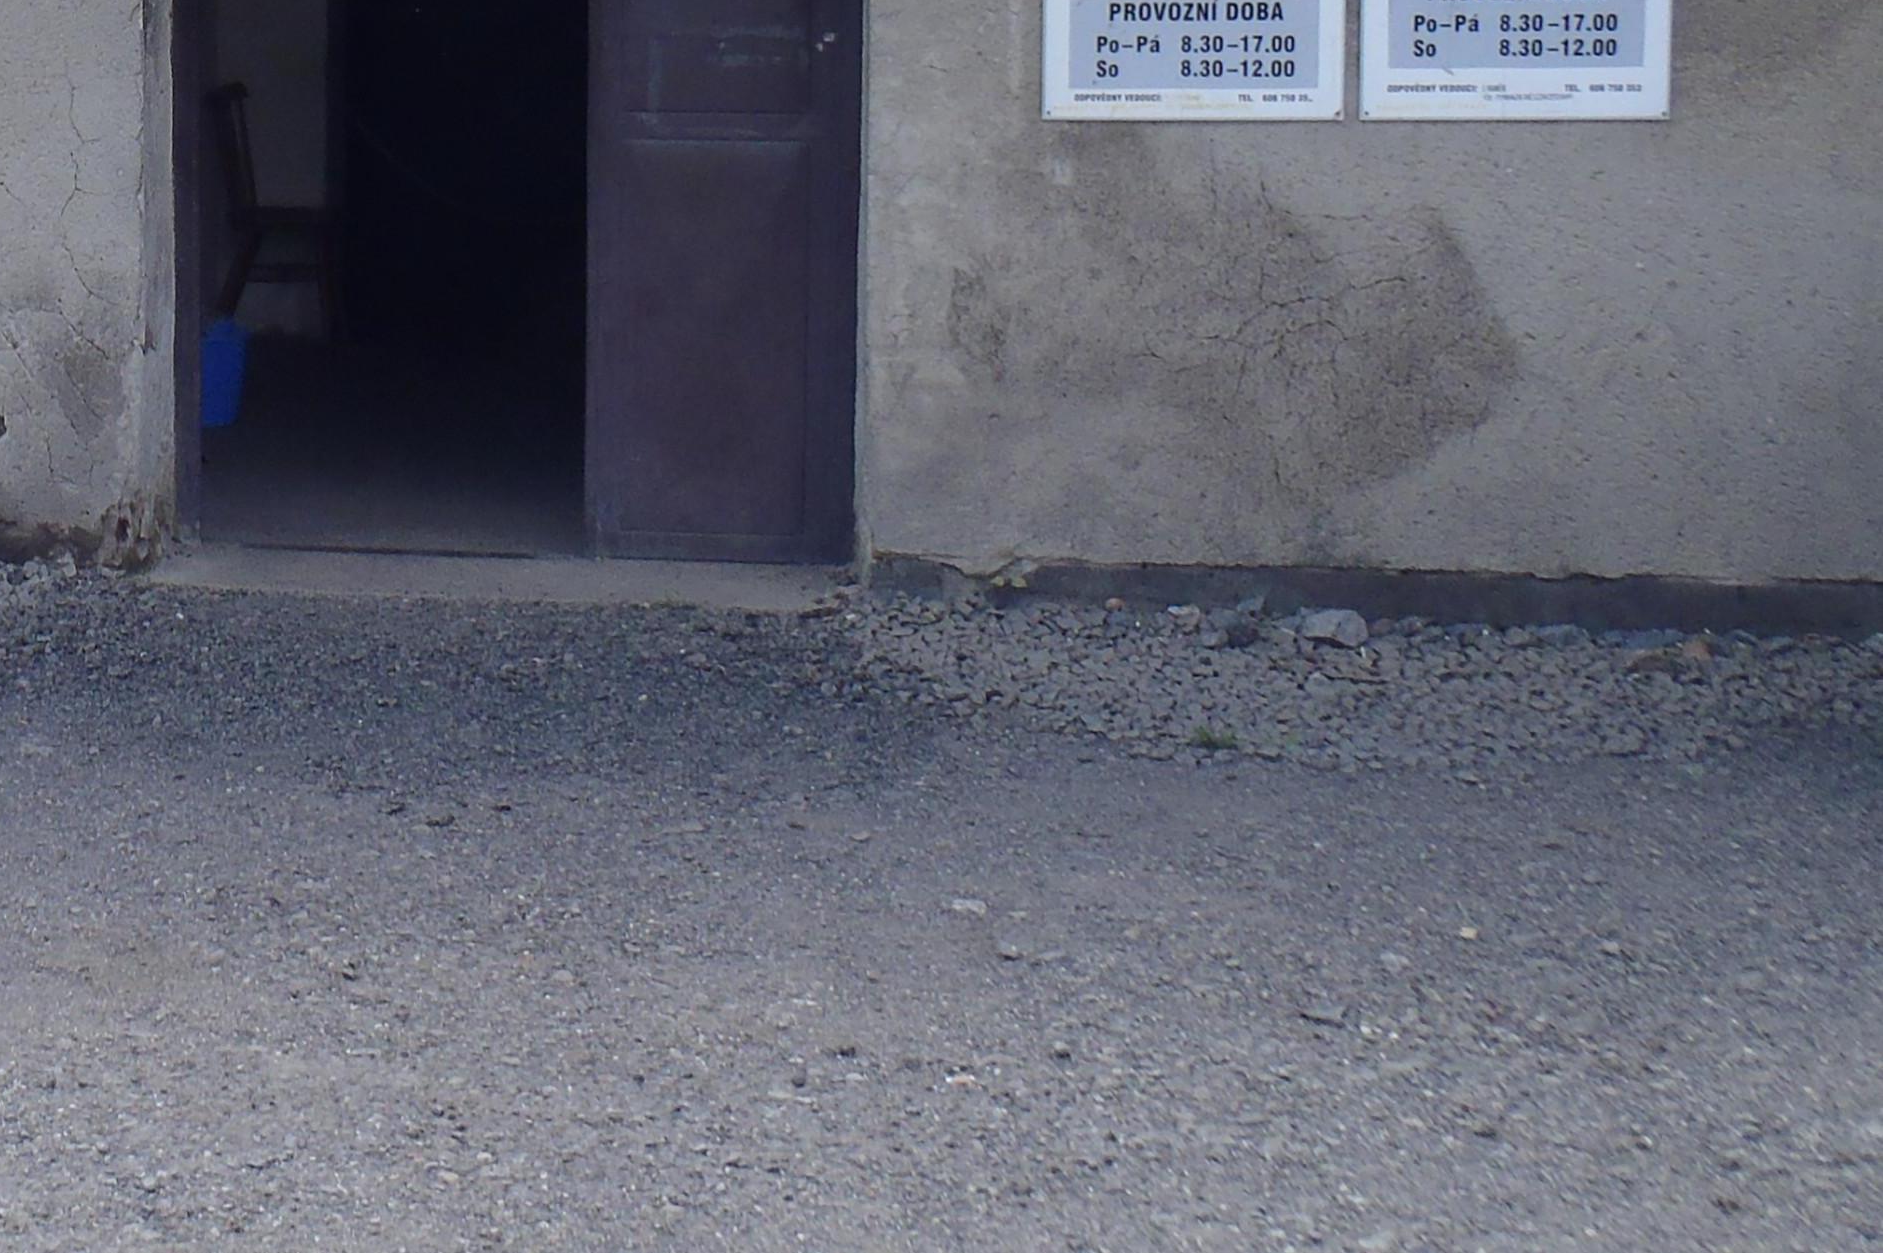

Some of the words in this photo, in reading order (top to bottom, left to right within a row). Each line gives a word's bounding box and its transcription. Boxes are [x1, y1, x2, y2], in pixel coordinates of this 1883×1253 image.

[1225, 0, 1285, 22] DOBA
[1413, 38, 1437, 58] So
[1095, 59, 1120, 78] So
